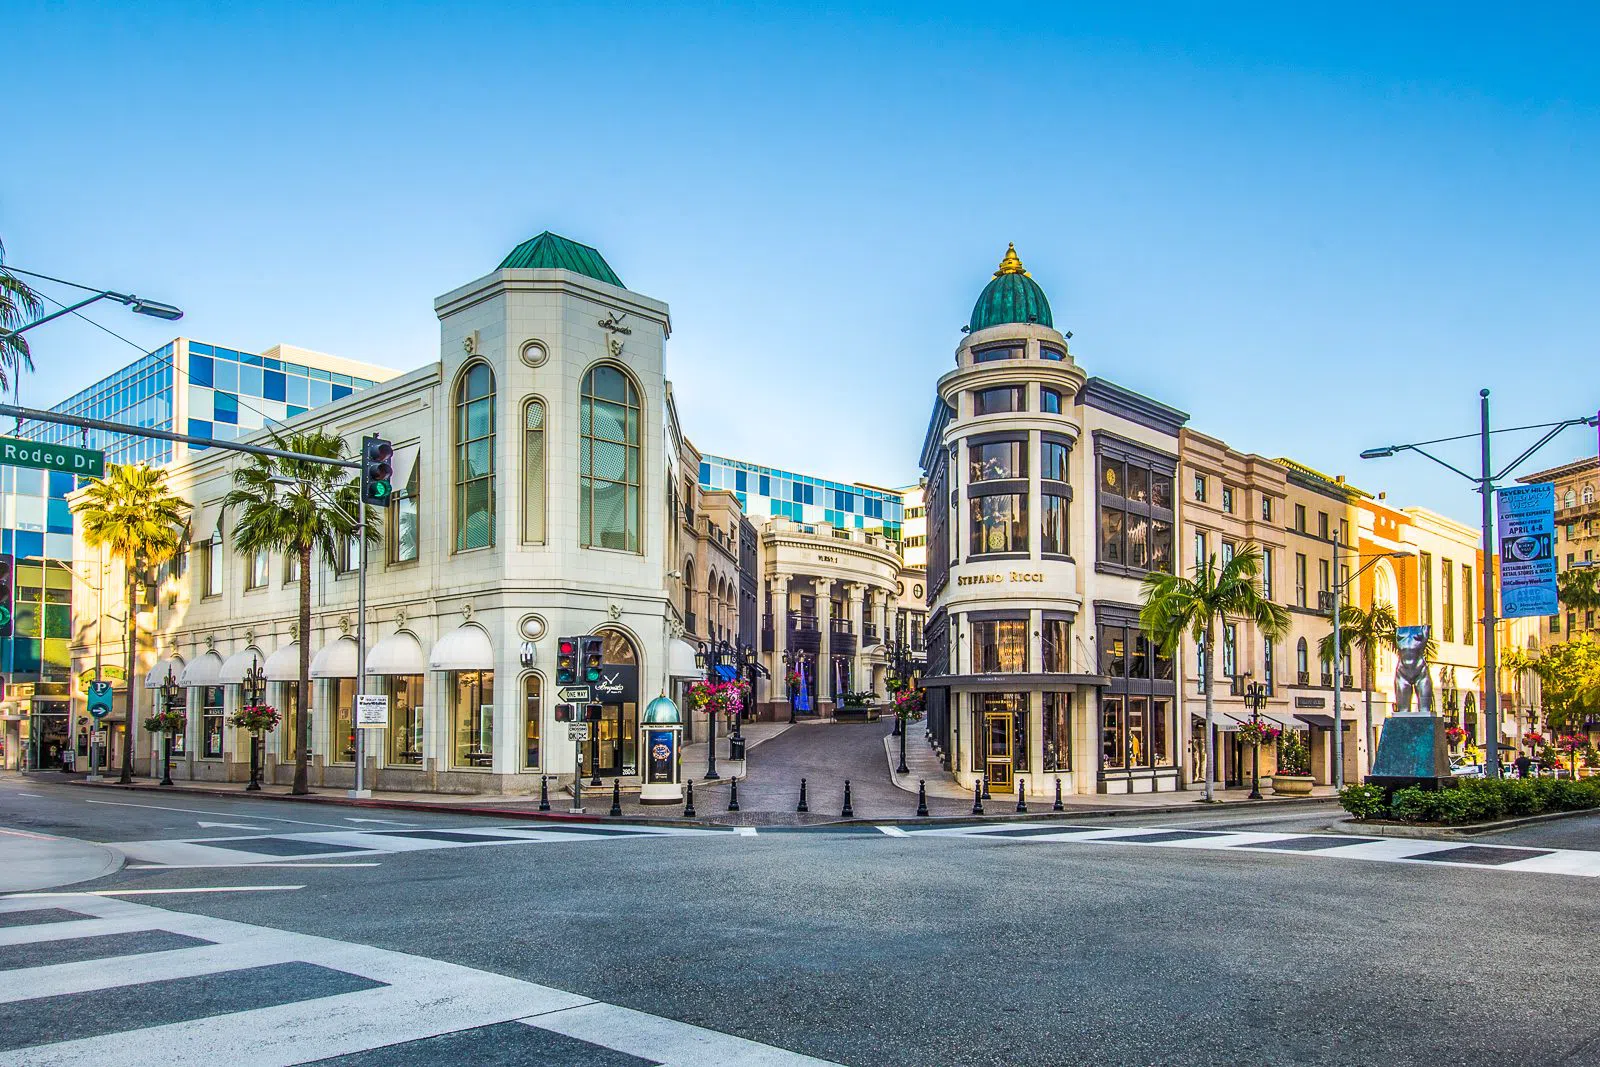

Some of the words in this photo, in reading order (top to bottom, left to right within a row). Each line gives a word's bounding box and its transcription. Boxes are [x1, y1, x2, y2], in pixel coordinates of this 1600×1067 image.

[4, 444, 66, 466] Rodeo
[74, 454, 96, 470] Dr
[1499, 489, 1529, 497] BEVERLY
[1508, 526, 1529, 535] APRIL
[1531, 524, 1544, 532] 4-8
[957, 574, 1004, 586] STEFANO
[1009, 571, 1045, 583] RICCI
[96, 682, 107, 692] P
[568, 732, 577, 740] OK
